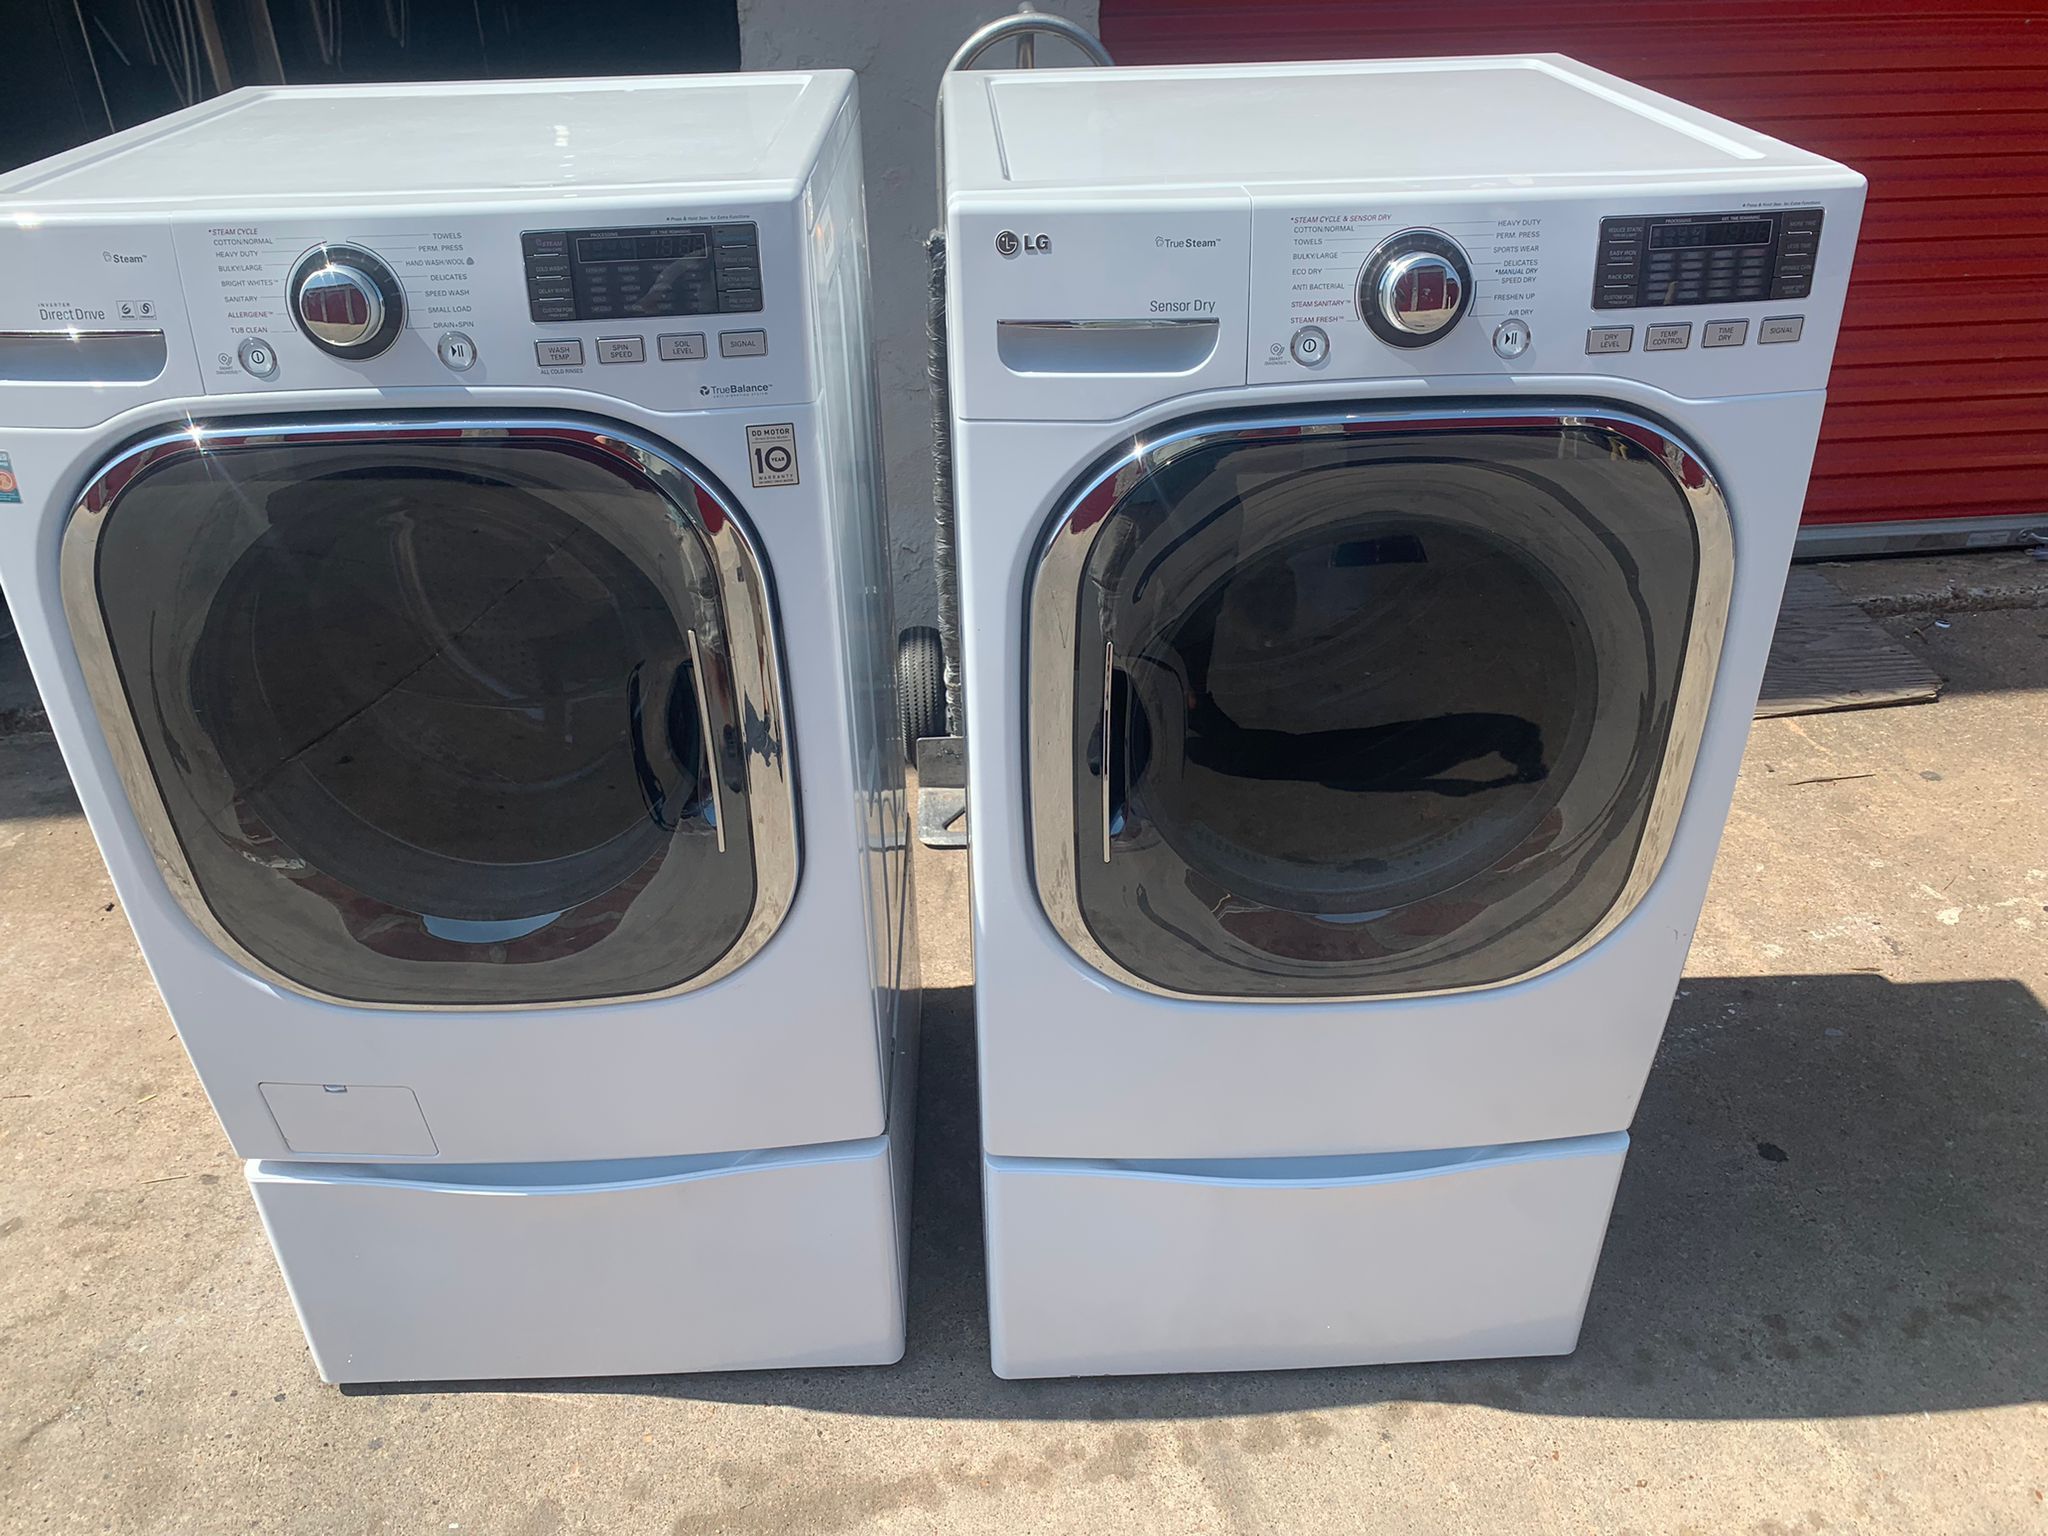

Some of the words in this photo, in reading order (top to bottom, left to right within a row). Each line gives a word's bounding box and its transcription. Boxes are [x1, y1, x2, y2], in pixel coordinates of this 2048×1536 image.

[1294, 216, 1318, 224] STEAM
[1349, 214, 1376, 222] SENSOR
[1522, 218, 1541, 226] DUTY
[212, 228, 236, 236] STEAM
[236, 228, 258, 236] CYCLE
[432, 232, 462, 240] TOWELS
[1518, 230, 1540, 238] PRESS
[1024, 234, 1050, 250] LG
[1294, 238, 1322, 246] TOWELS
[440, 244, 464, 252] PRESS
[240, 250, 258, 258] DUTY
[1504, 259, 1538, 267] DELICATES
[1292, 268, 1307, 276] ECO
[430, 273, 468, 281] DELICATES
[221, 280, 246, 288] BRIGHT
[1309, 282, 1344, 290] BACTERIAL
[1494, 293, 1524, 301] FRESHEN
[1525, 292, 1536, 300] UP
[1150, 300, 1191, 313] Sensor
[1194, 300, 1216, 314] Dry
[1291, 300, 1313, 308] STEAM
[39, 308, 74, 320] Direct
[76, 308, 106, 320] Drive
[427, 306, 452, 314] SMALL
[1520, 308, 1534, 316] DRY
[1290, 316, 1314, 324] STEAM
[246, 326, 268, 334] CLEAN
[1718, 326, 1734, 334] TIME
[1770, 326, 1794, 334] SIGNAL
[1604, 333, 1619, 341] DRY
[1718, 334, 1732, 342] DRY
[674, 340, 690, 348] SOIL
[730, 340, 756, 348] SIGNAL
[1600, 340, 1620, 348] LEVEL
[1652, 338, 1684, 346] CONTROL
[548, 346, 570, 354] WASH
[612, 344, 629, 352] SPIN
[672, 348, 693, 356] LEVEL
[610, 350, 632, 358] SPEED
[764, 428, 790, 436] MOTOR
[754, 446, 792, 474] 10
